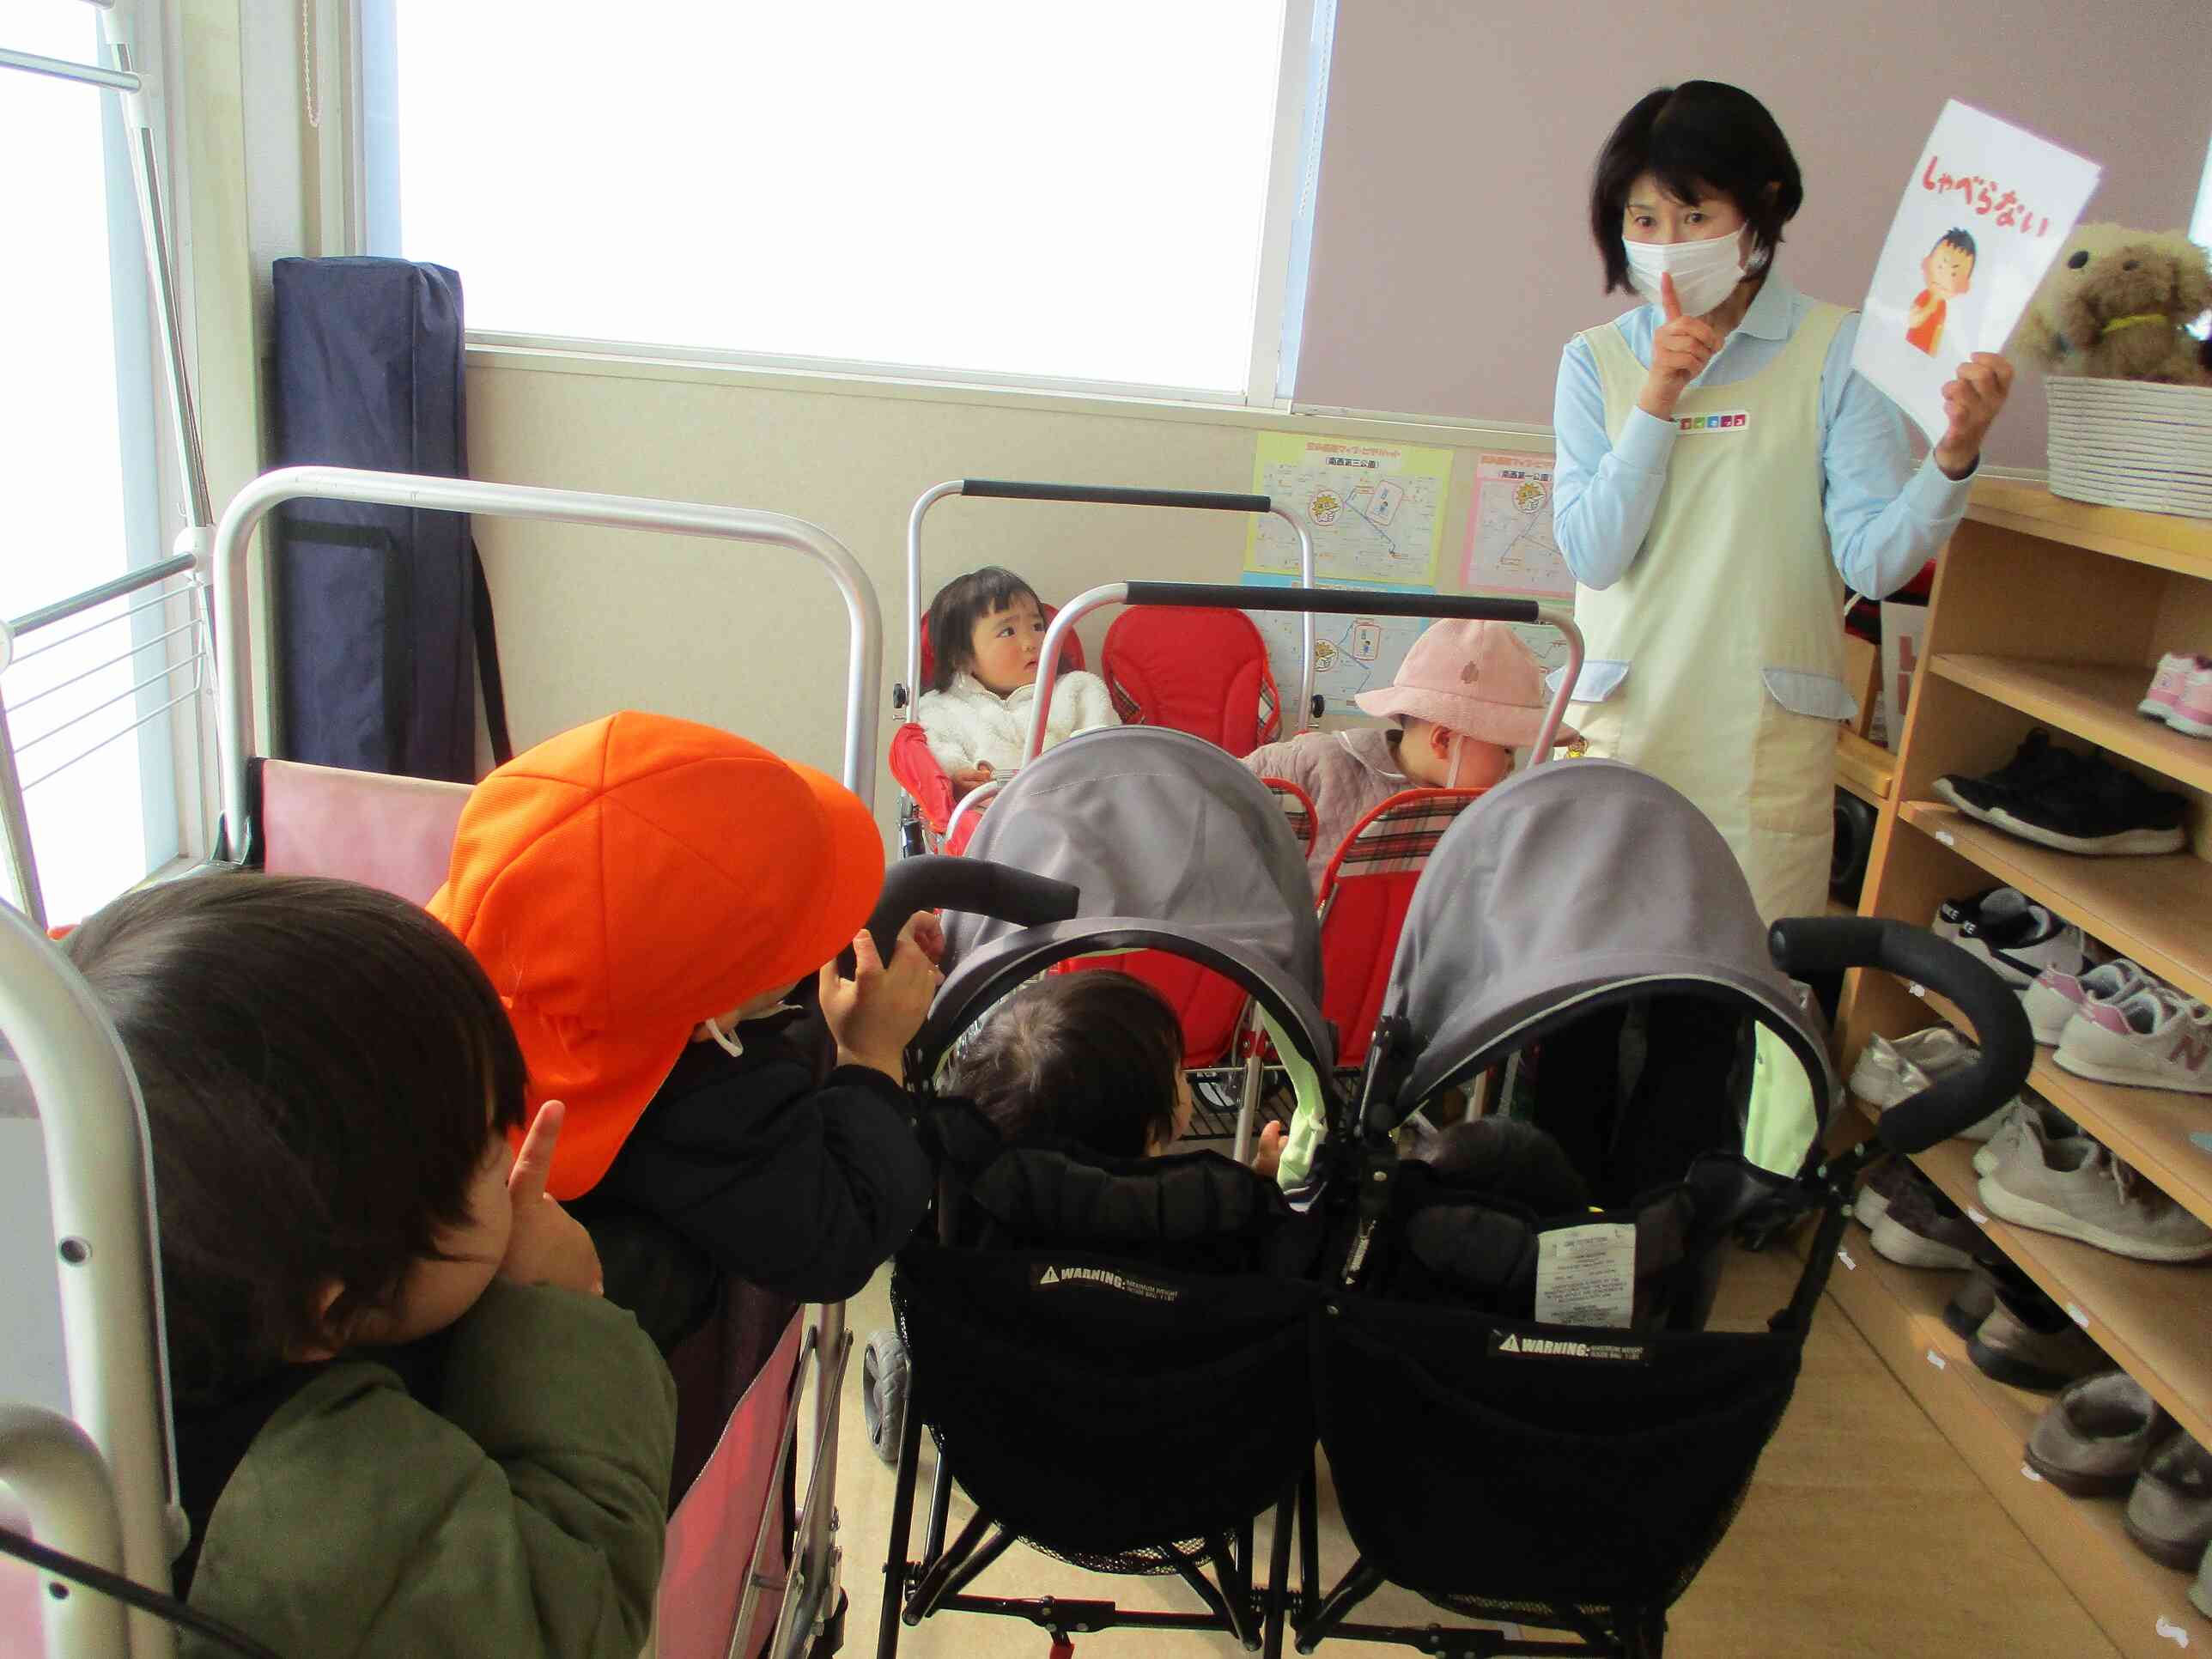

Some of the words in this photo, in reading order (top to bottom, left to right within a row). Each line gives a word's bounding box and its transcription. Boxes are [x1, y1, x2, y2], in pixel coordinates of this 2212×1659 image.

[1922, 155, 2049, 238] しゃべらない
[1060, 1267, 1126, 1290] WARNING:
[1522, 1338, 1590, 1358] WARNING:
